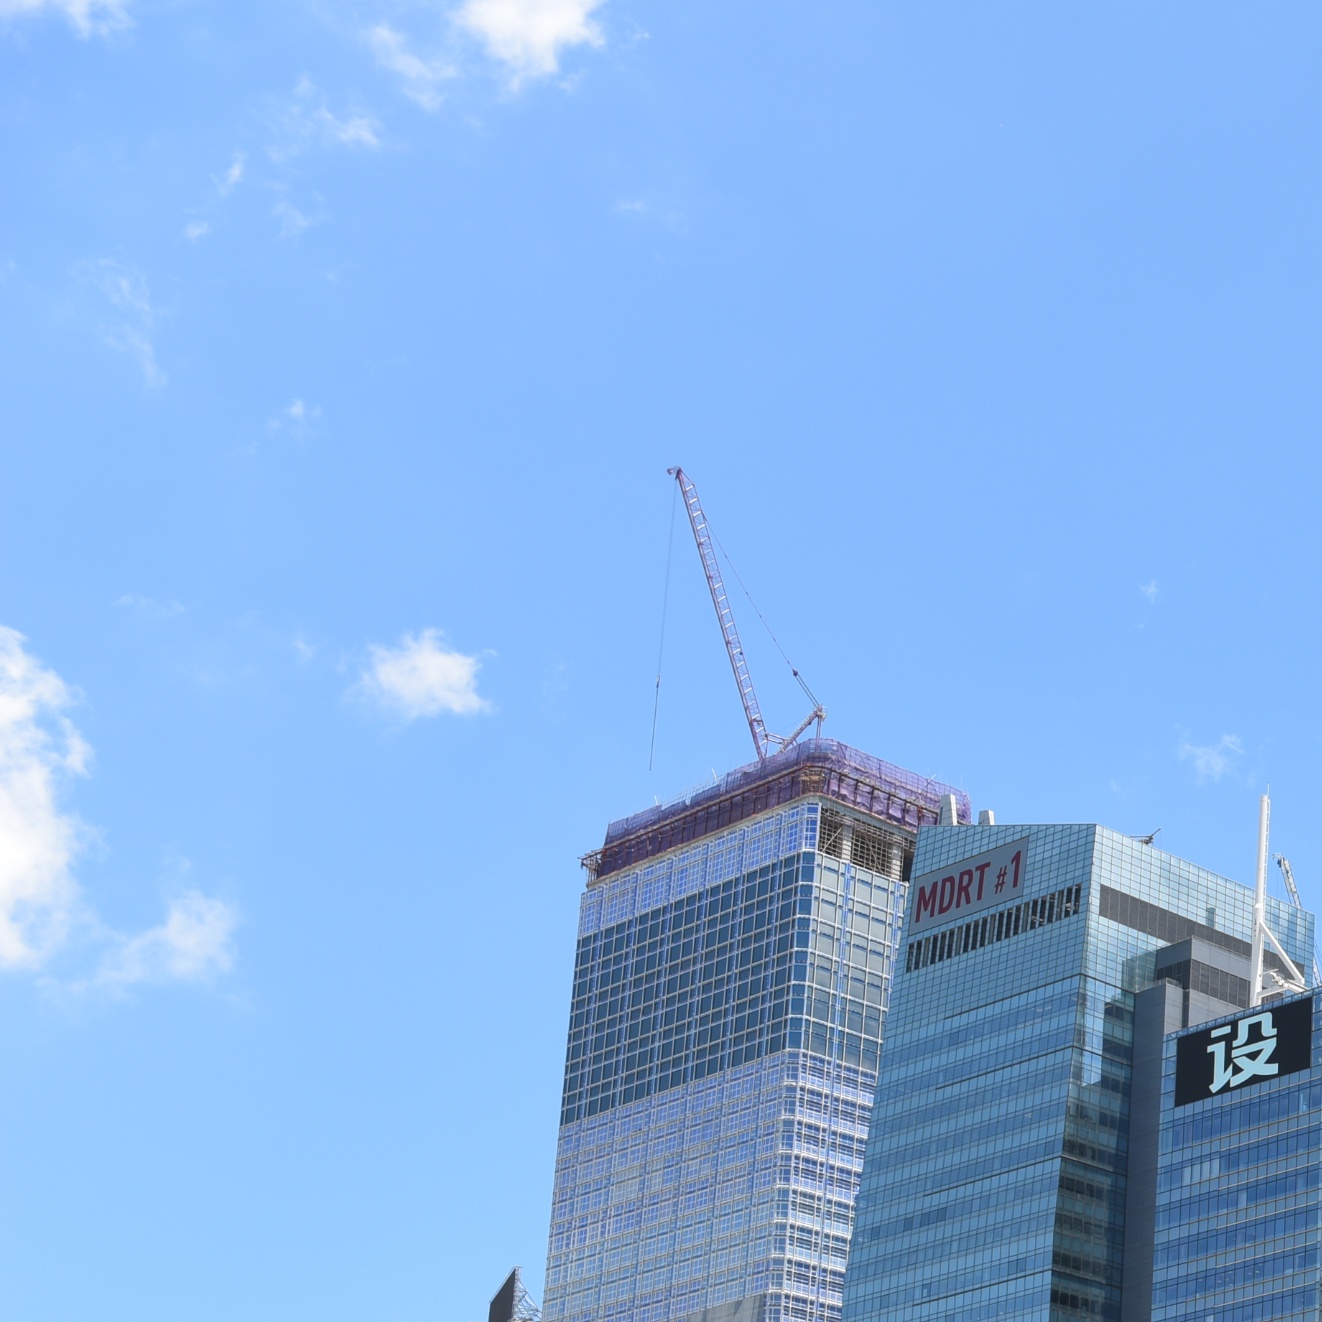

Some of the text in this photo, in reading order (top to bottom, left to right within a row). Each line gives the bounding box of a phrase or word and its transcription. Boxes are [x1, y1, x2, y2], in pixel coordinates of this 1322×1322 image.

[914, 850, 1022, 923] MDRT #1
[1206, 1011, 1279, 1094] 设
